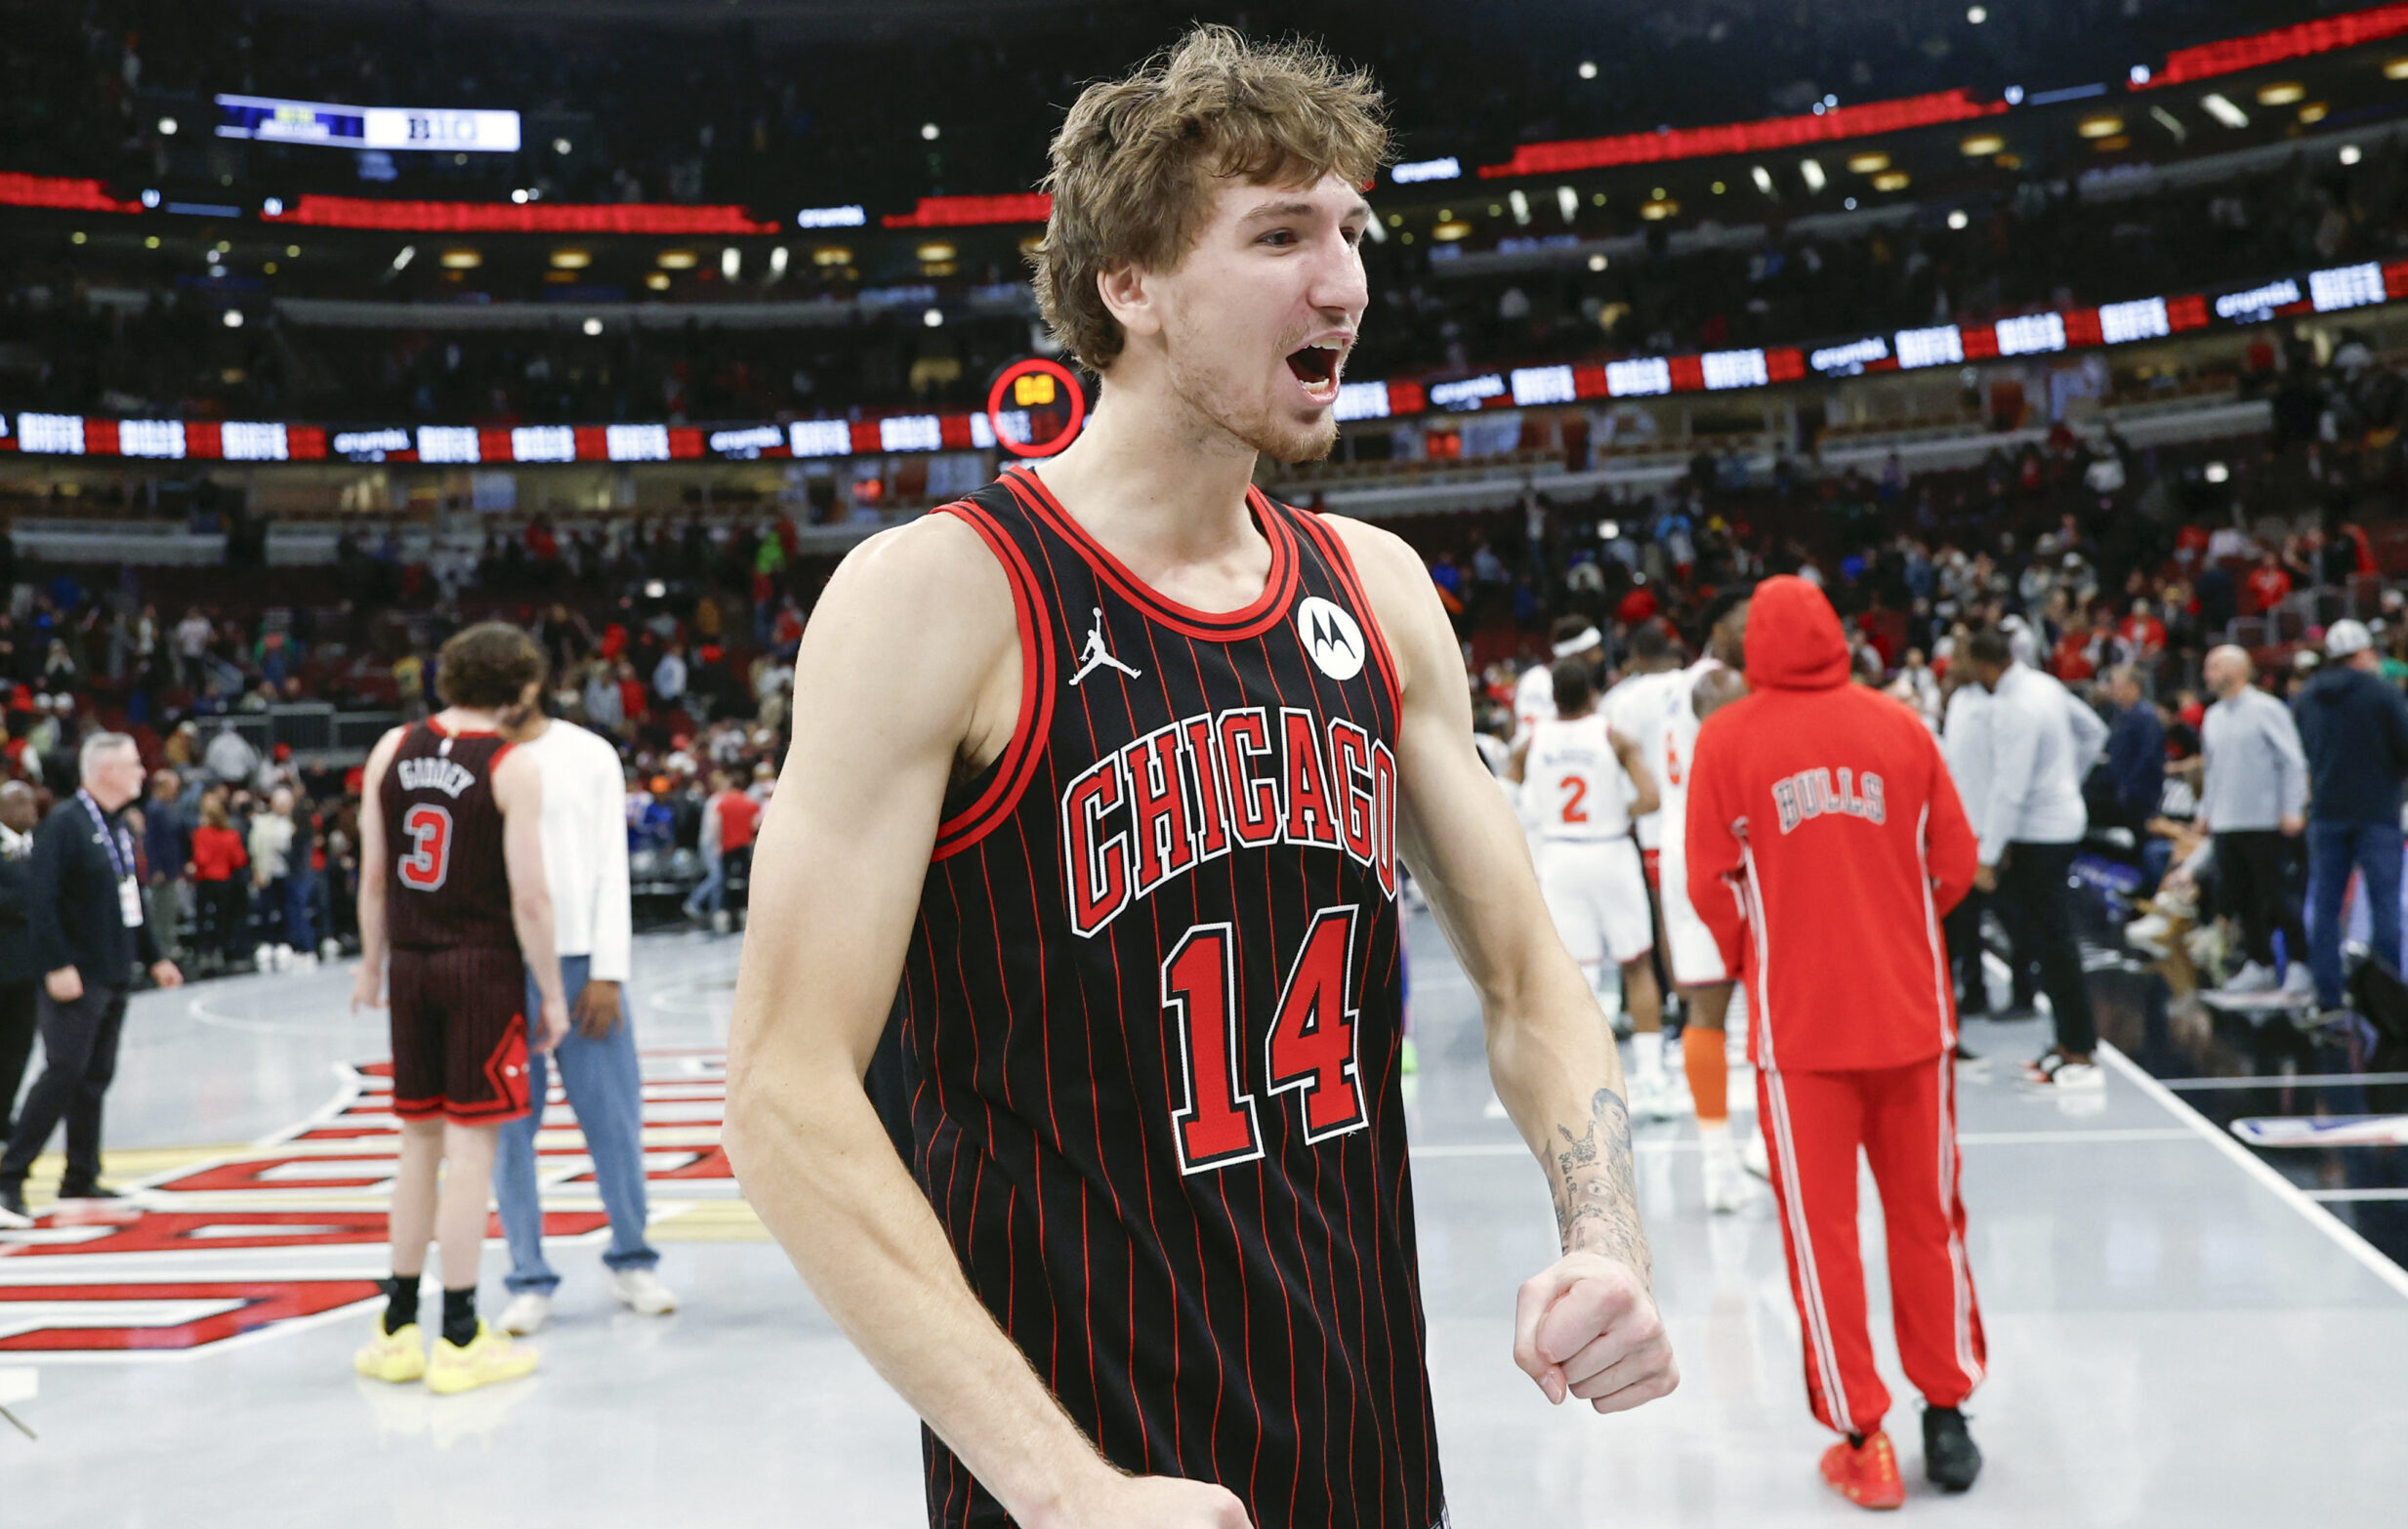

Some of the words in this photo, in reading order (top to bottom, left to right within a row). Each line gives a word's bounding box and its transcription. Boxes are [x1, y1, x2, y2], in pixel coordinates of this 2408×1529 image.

[1061, 706, 1397, 938] CHICAGO
[1559, 775, 1588, 824] 2
[1771, 766, 1887, 835] BULLS
[397, 802, 453, 892] 3
[1161, 904, 1369, 1176] 14
